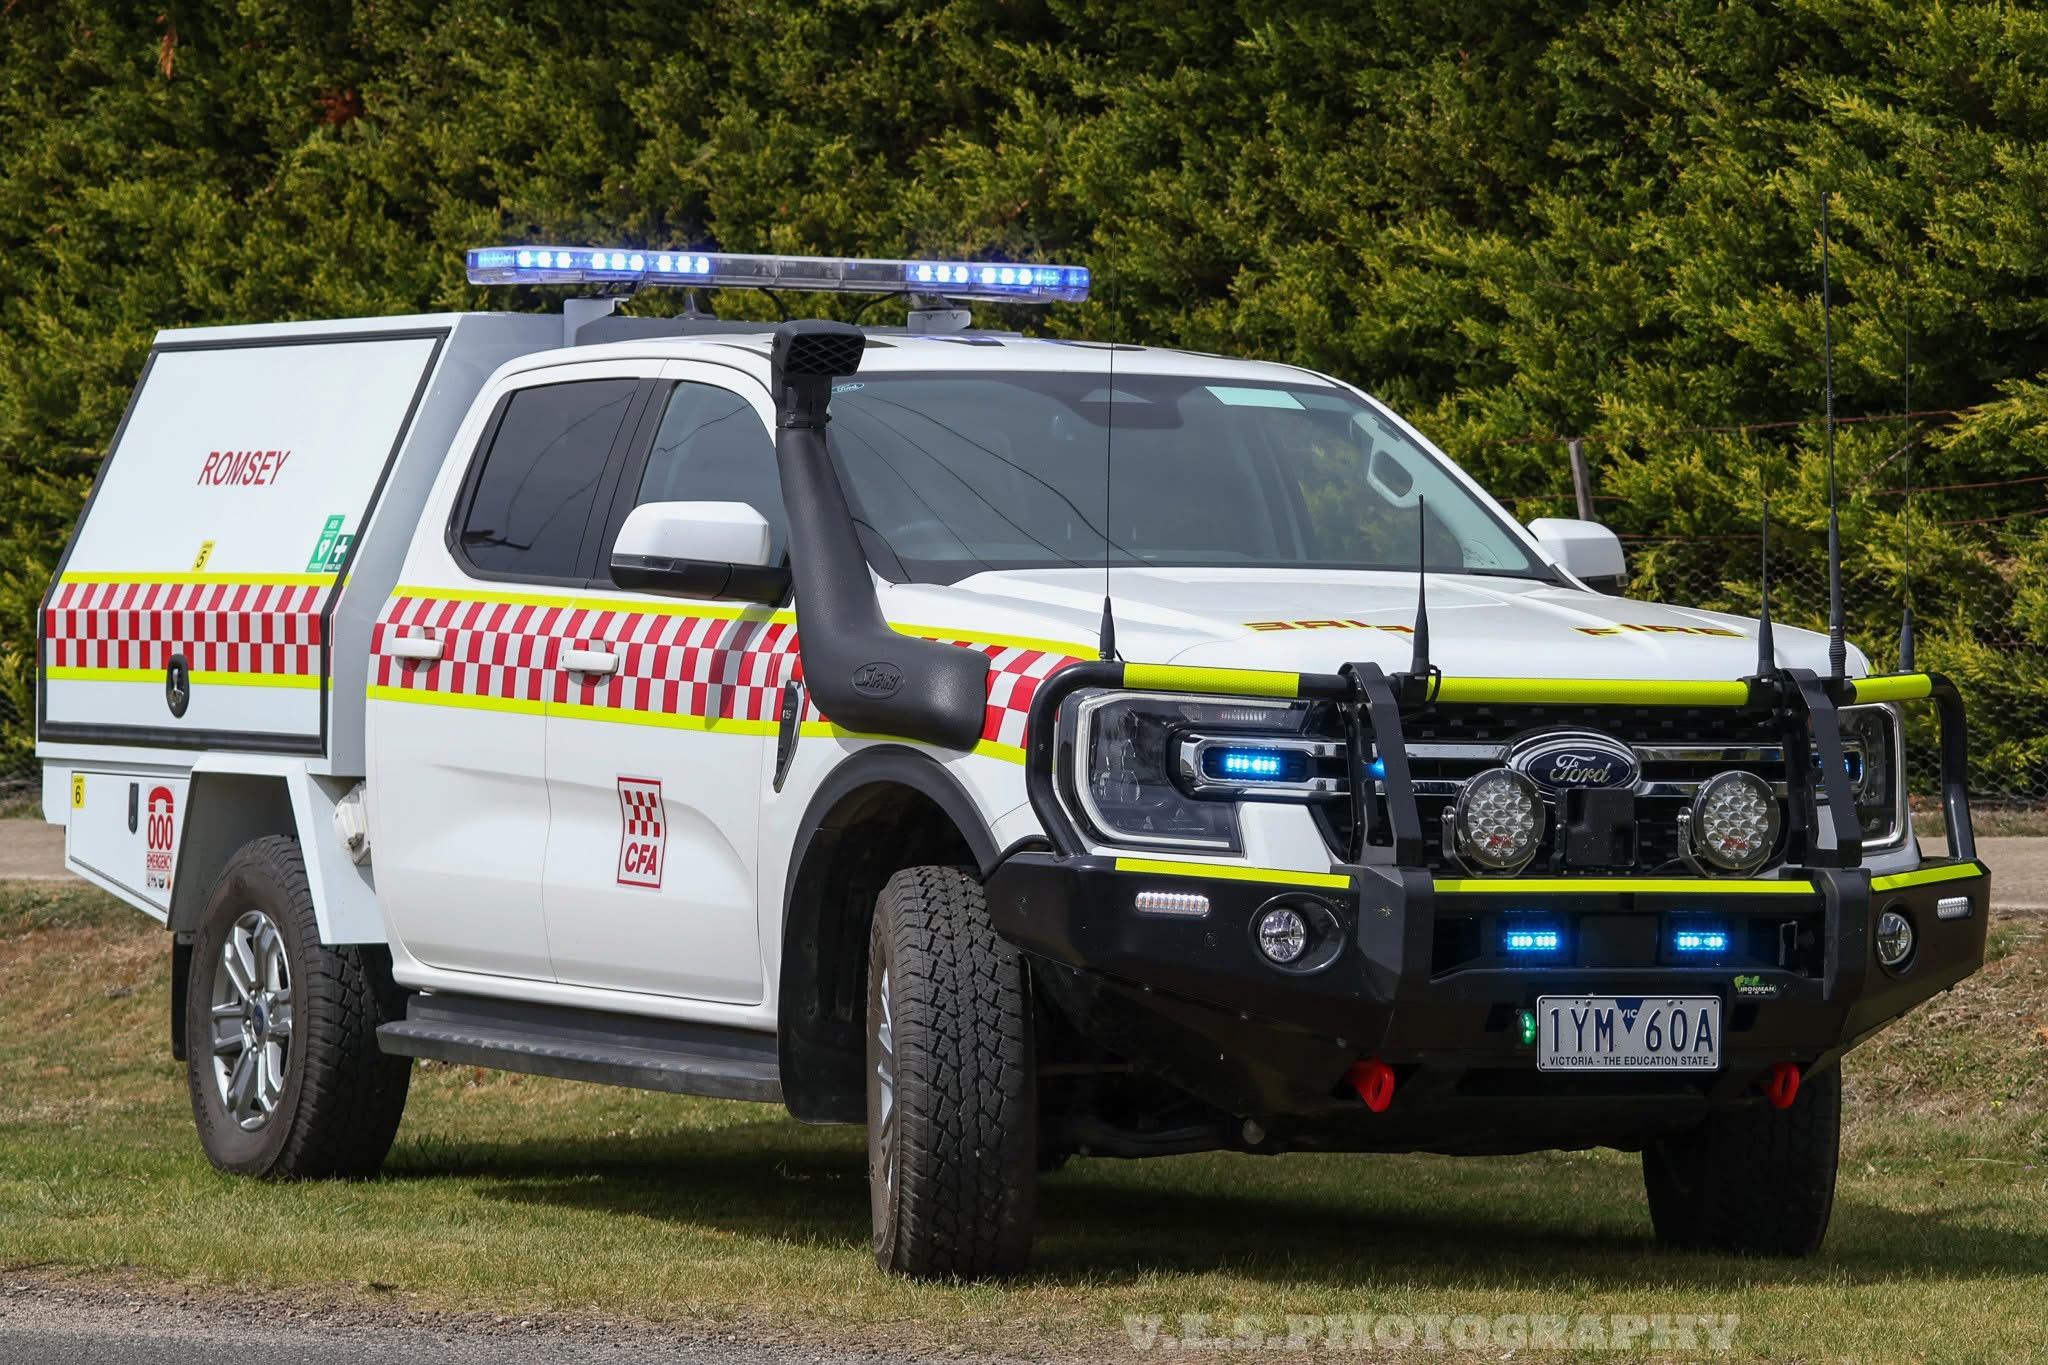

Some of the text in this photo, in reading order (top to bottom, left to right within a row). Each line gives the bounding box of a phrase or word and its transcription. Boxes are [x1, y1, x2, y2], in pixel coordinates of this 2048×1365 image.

[197, 450, 291, 486] ROMSEY
[197, 550, 207, 568] 5
[1571, 624, 1749, 639] FIRE
[855, 667, 901, 690] SAFARI
[1549, 754, 1611, 784] Ford
[76, 785, 81, 804] 6
[148, 814, 173, 850] 000
[625, 842, 657, 876] CFA
[1620, 1009, 1638, 1018] VIC
[1549, 1007, 1614, 1052] 1YM
[1549, 1056, 1593, 1066] VICTORIA
[1604, 1056, 1621, 1066] THE
[1625, 1056, 1678, 1066] EDUCATION
[1681, 1056, 1709, 1066] STATE
